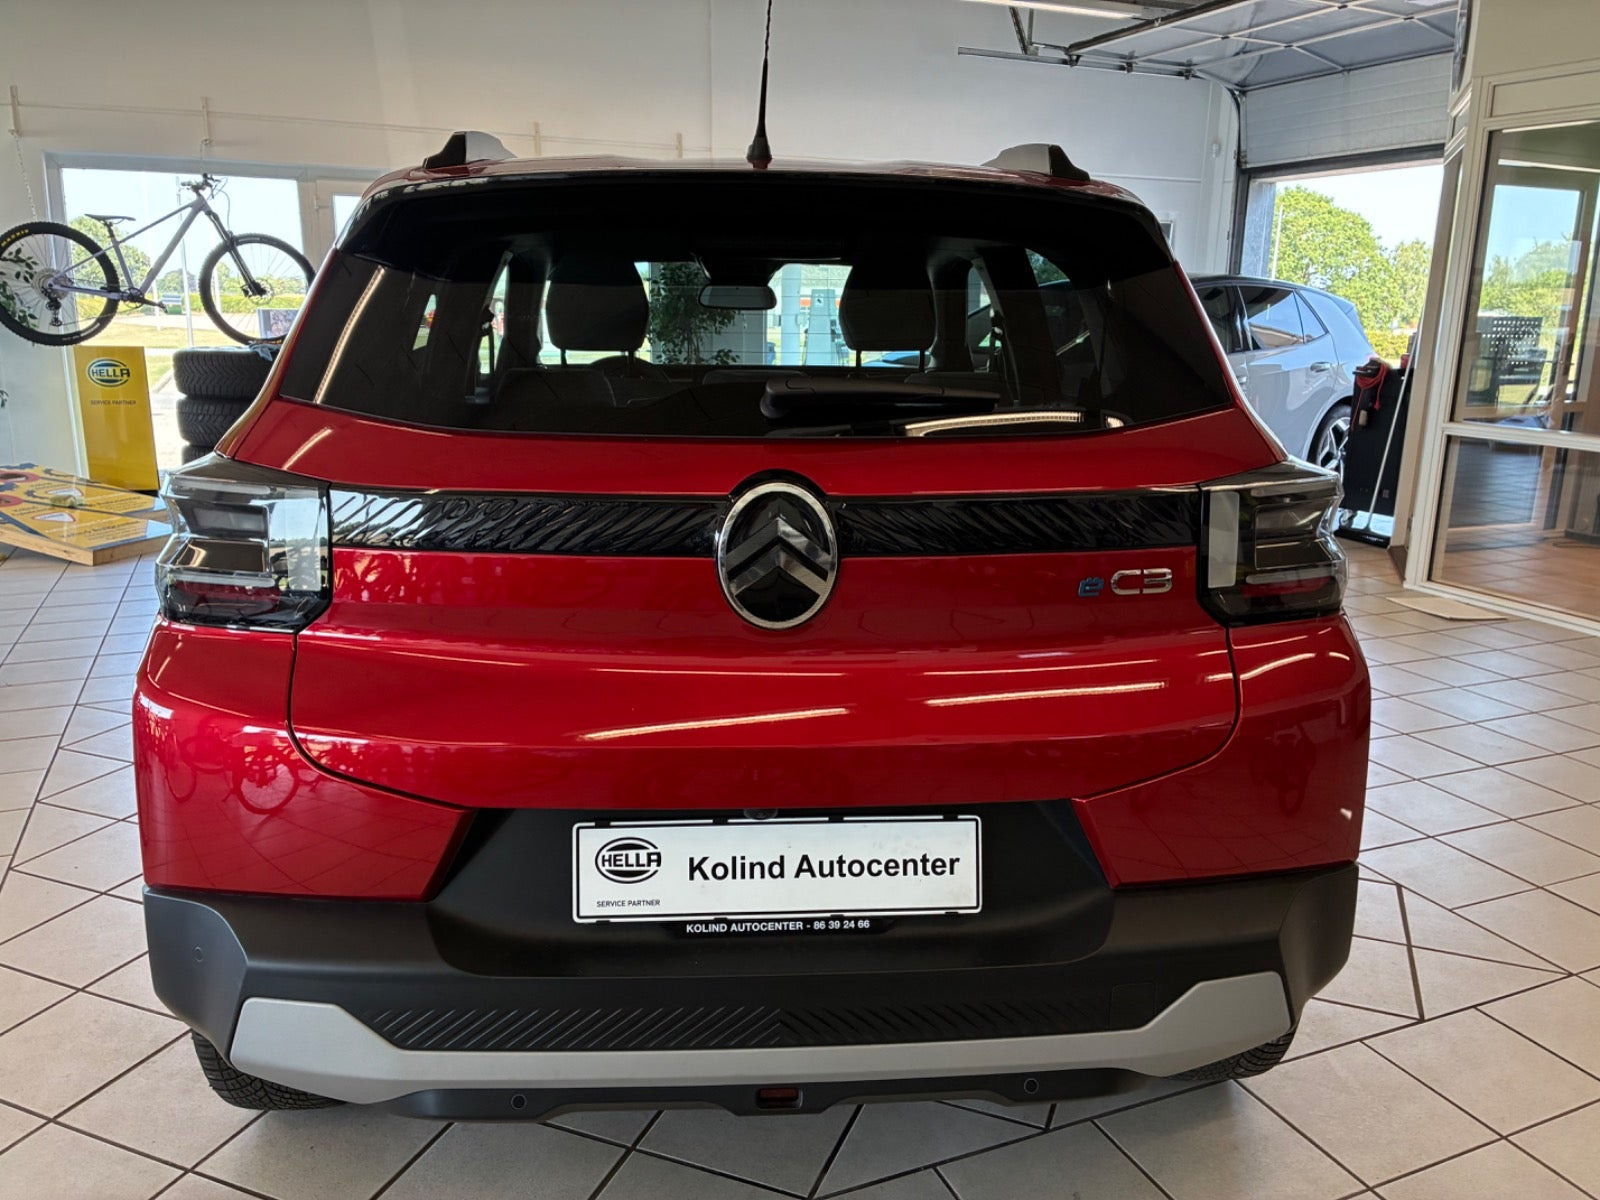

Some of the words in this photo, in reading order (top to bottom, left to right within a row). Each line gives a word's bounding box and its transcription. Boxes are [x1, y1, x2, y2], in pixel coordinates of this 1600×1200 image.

[91, 368, 131, 378] HELLA
[1111, 568, 1172, 595] C3
[601, 852, 662, 868] HELLA
[688, 855, 785, 881] Kolind
[794, 853, 960, 879] Autocenter
[596, 900, 626, 908] SERVICE
[627, 899, 660, 907] PARTNER
[686, 923, 728, 933] KOLIND
[730, 921, 804, 932] AUTOCENTER
[813, 920, 826, 930] 86
[828, 920, 840, 929] 39
[843, 920, 855, 929] 24
[857, 919, 870, 929] 66
